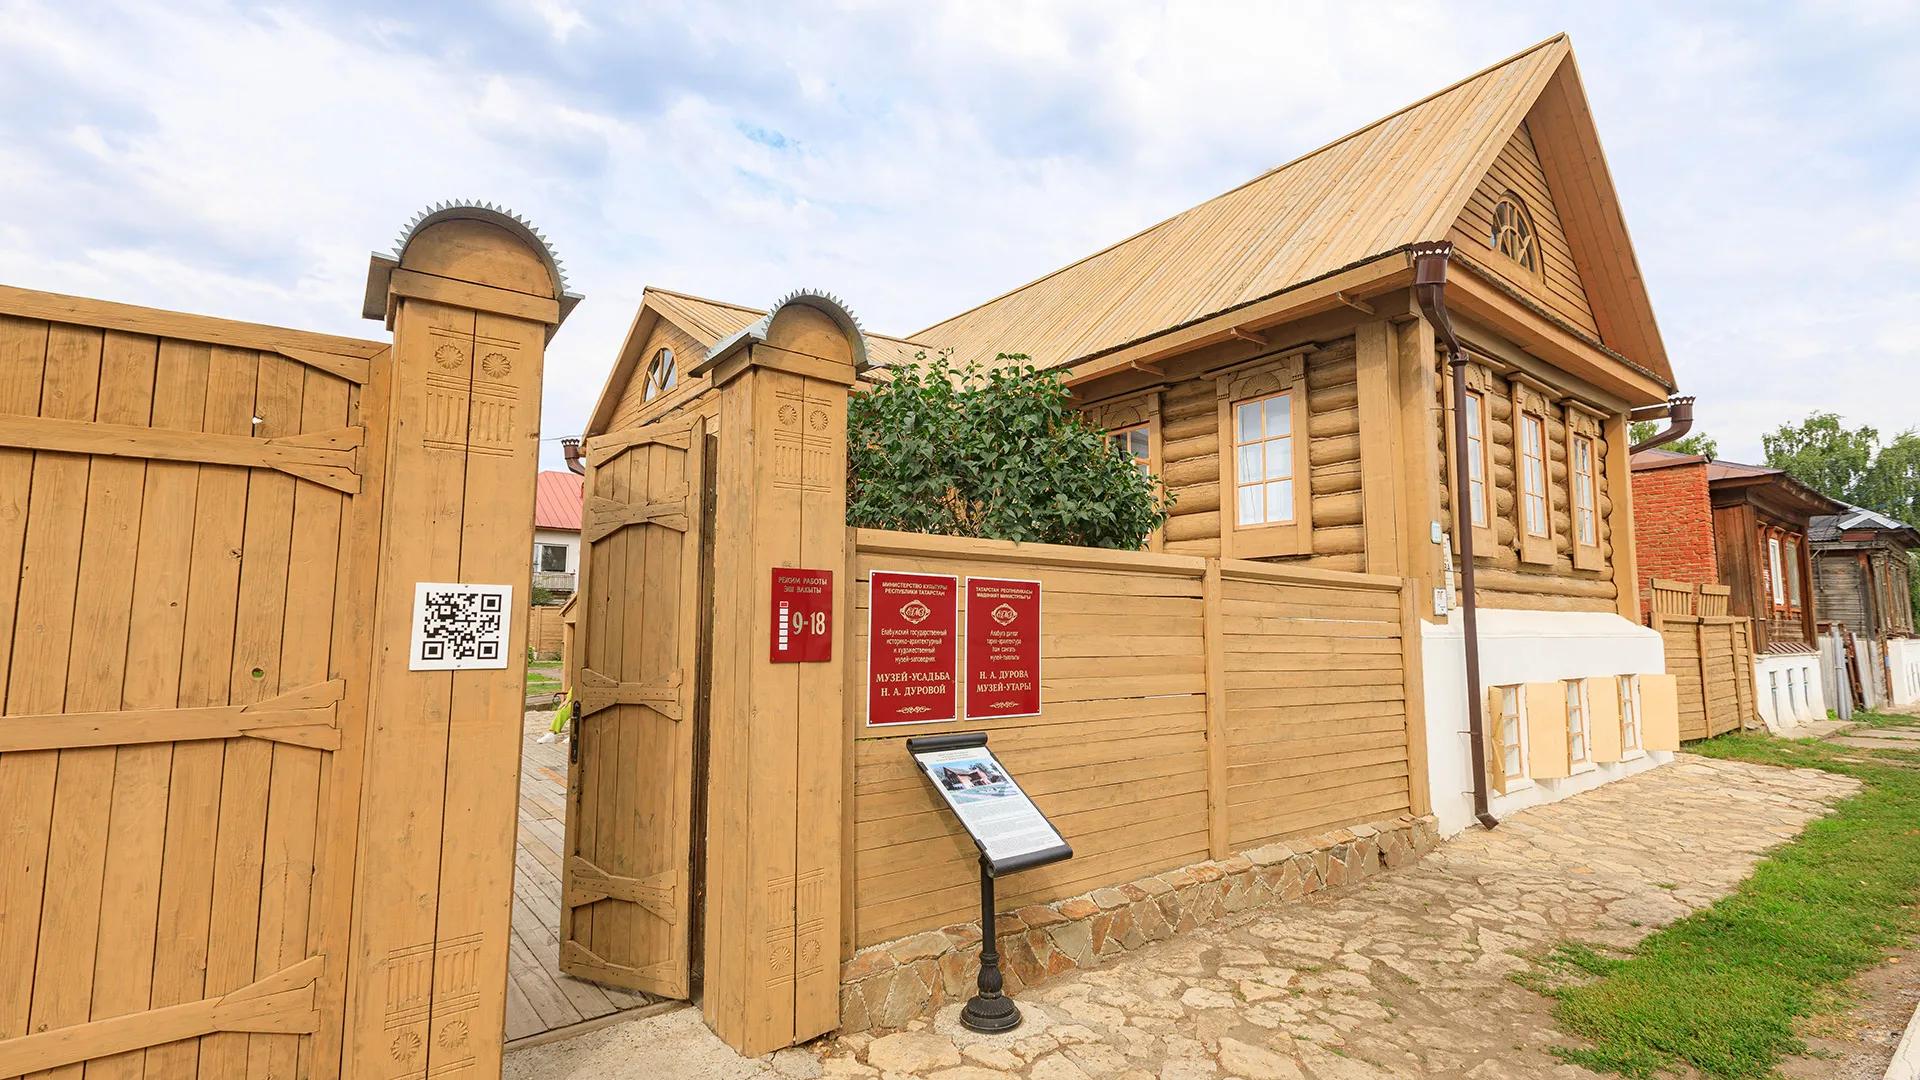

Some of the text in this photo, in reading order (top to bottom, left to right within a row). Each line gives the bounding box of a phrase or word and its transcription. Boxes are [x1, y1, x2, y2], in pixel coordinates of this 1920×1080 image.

[803, 577, 828, 585] РАБОТЫ
[792, 611, 825, 635] 9-18
[881, 628, 947, 637] Елабужский государственный
[886, 638, 942, 646] историко-архитектурный
[898, 647, 936, 655] художественный
[895, 655, 935, 664] музей-заповедник
[979, 670, 1029, 680] Н. А. ДУРОВА
[881, 684, 946, 696] Н. А. ДУРОВОЙ
[976, 682, 1032, 693] МУЗЕЙ-УТАРЫ
